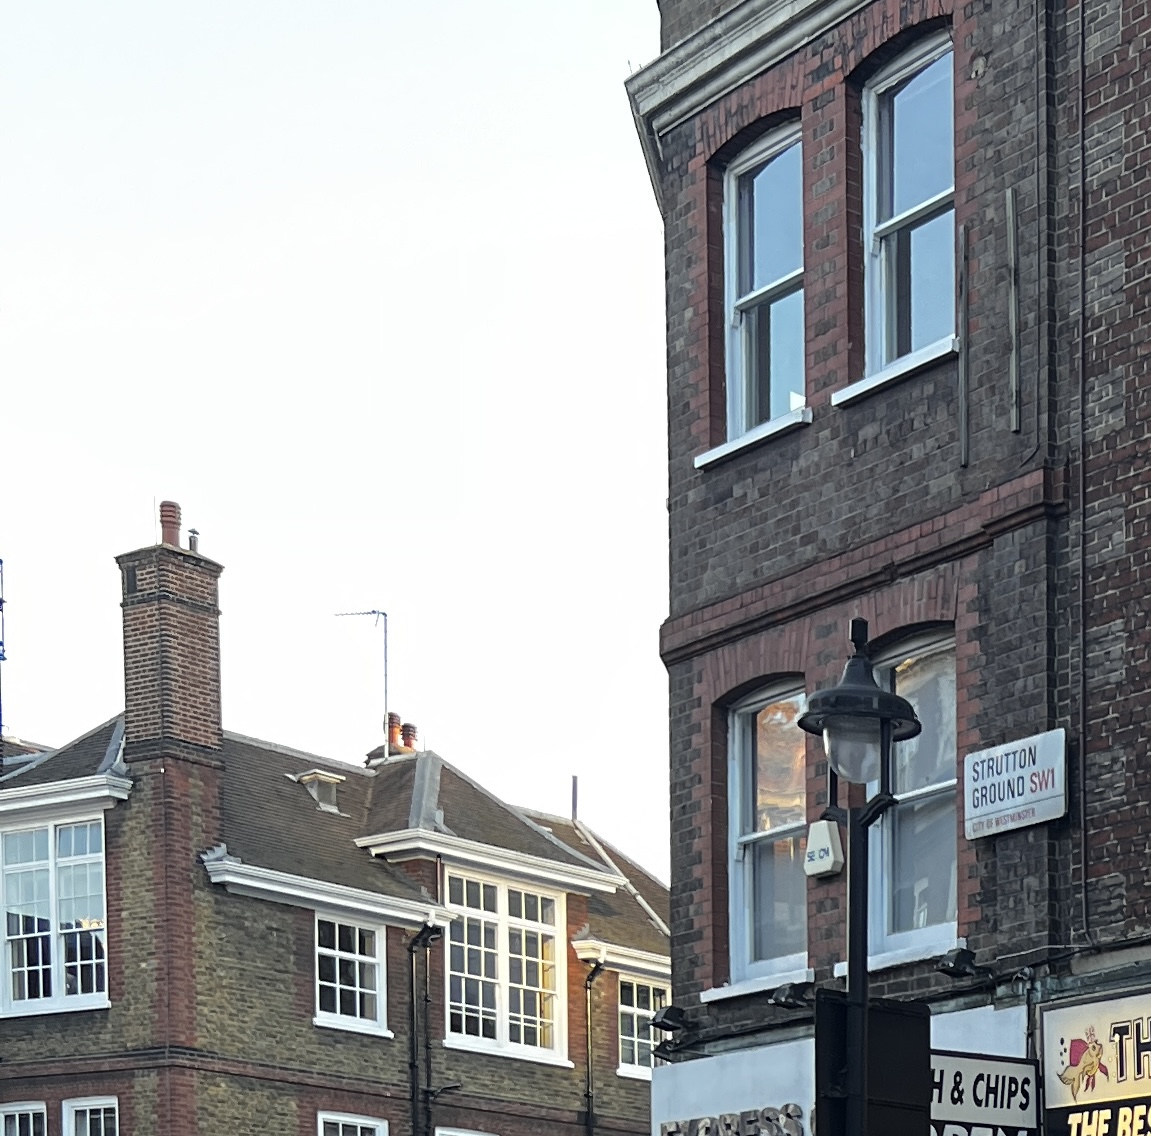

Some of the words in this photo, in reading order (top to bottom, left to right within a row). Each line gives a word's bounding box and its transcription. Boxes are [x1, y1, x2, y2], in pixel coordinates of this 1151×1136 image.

[972, 745, 1037, 783] STRUTTON
[972, 775, 1025, 809] GROUND
[1029, 767, 1055, 794] SW1
[950, 1071, 965, 1105] &
[972, 1072, 1031, 1112] CHIPS
